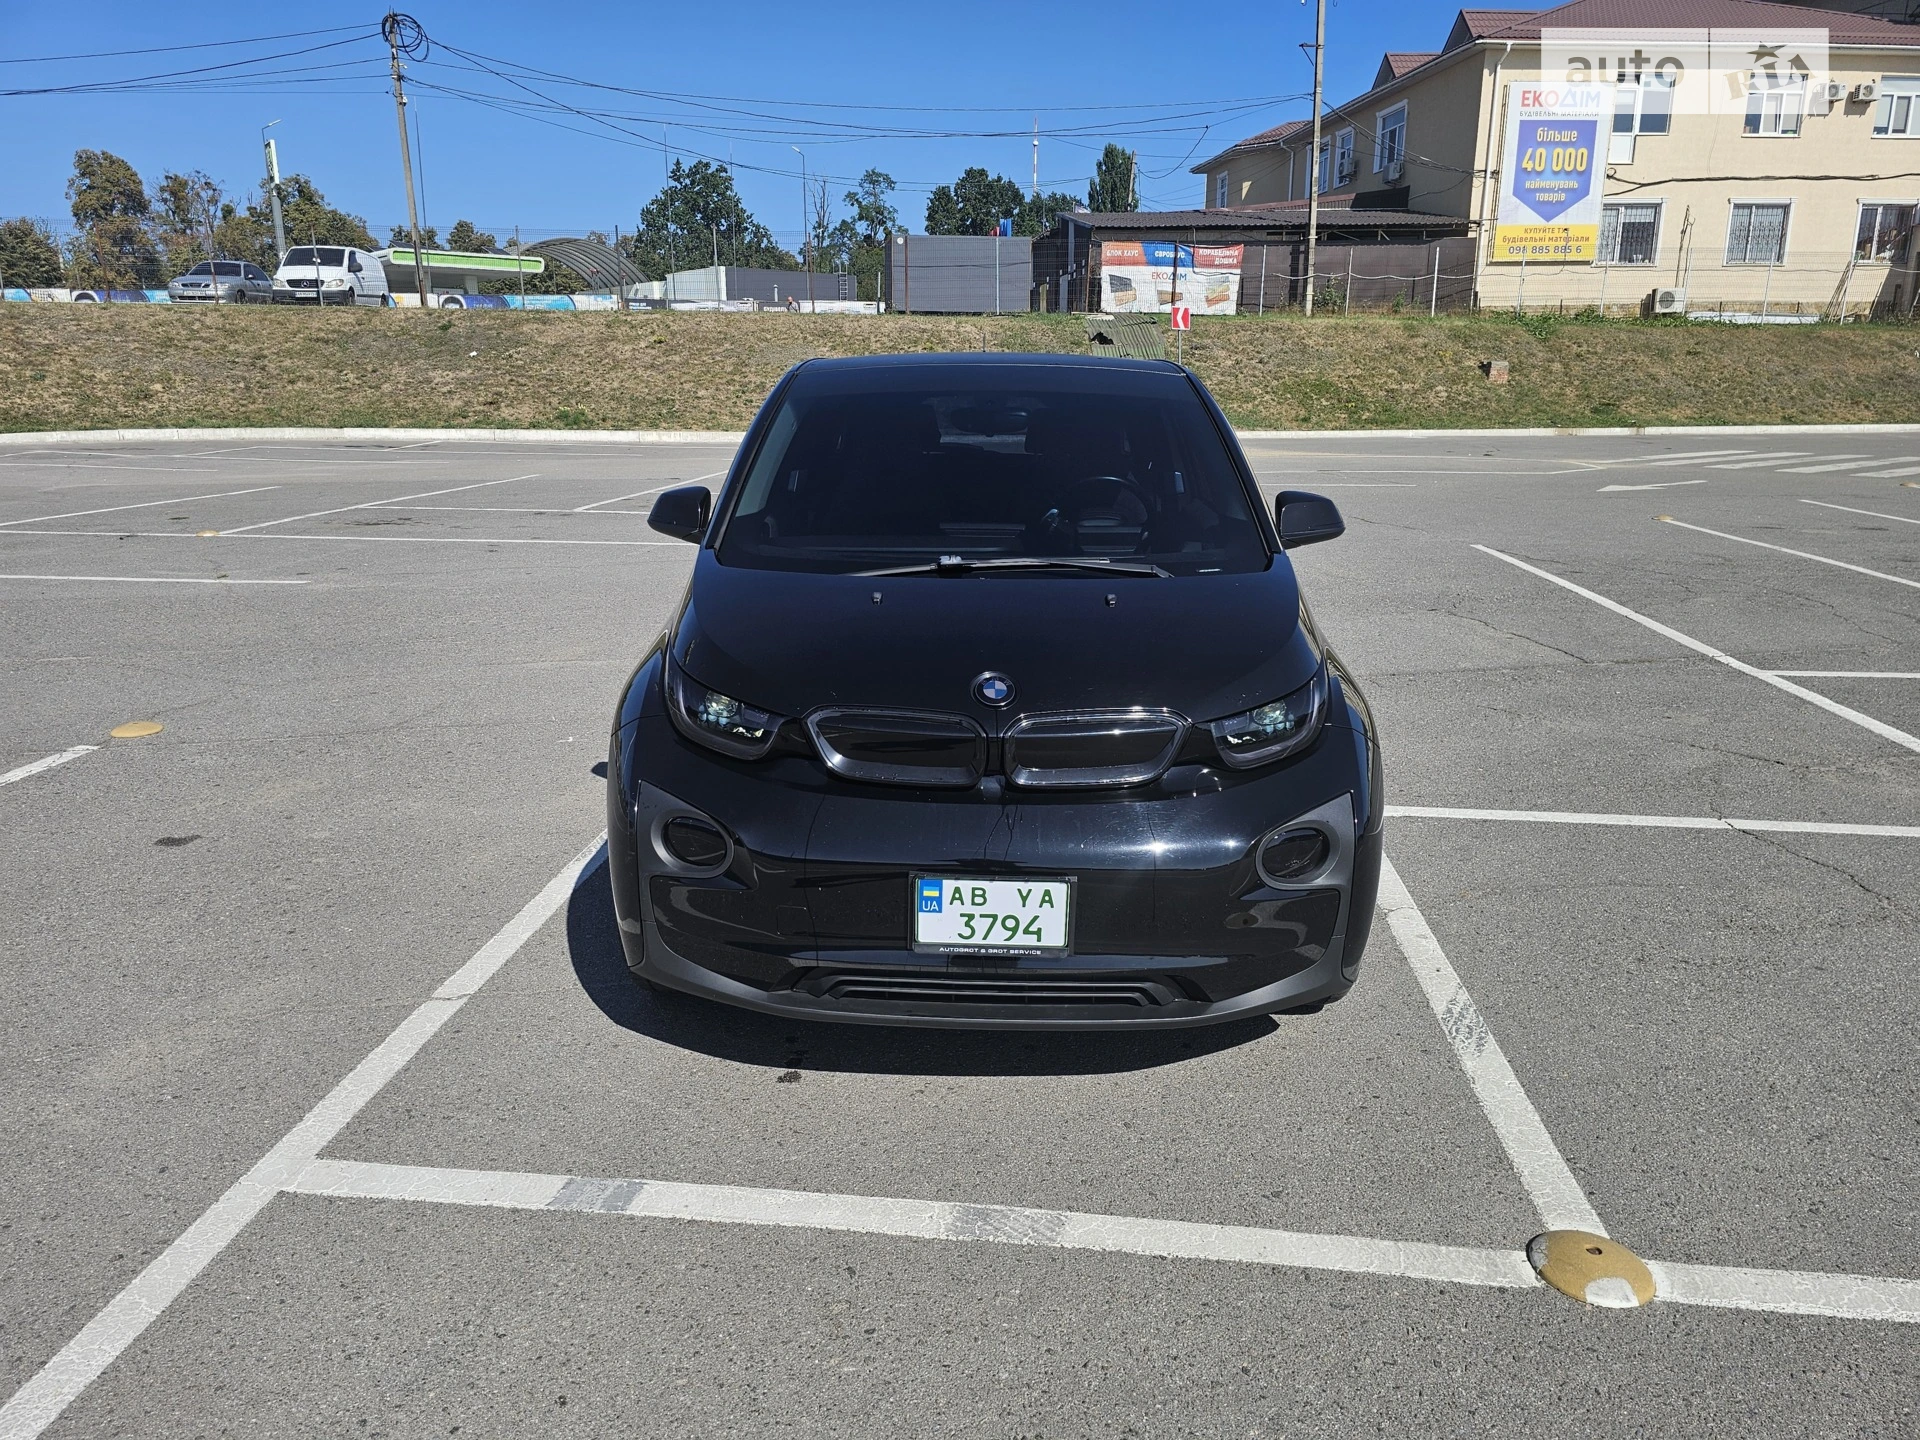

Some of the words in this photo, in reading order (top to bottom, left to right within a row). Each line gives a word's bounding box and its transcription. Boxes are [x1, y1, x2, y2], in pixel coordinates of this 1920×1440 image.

[1536, 127, 1578, 143] більше
[1521, 147, 1547, 172] 40
[1551, 147, 1589, 172] 000
[1525, 178, 1579, 191] найменувань
[1535, 191, 1566, 203] товарів
[1523, 226, 1556, 234] КУПУЙТЕ
[1502, 235, 1546, 245] будівельні
[1547, 234, 1590, 243] матеріали
[1106, 249, 1122, 257] БЛОК
[1123, 249, 1139, 257] ХАУС
[1154, 250, 1186, 259] ЄВРОБУС
[1198, 248, 1239, 256] КОРАБЕЛЬНА
[1508, 245, 1528, 255] 098
[1531, 245, 1551, 254] 885
[1553, 245, 1573, 254] 885
[1575, 245, 1582, 254] 6
[1214, 257, 1237, 265] ДОШКА
[949, 886, 988, 907] AB
[1017, 888, 1055, 908] YA
[922, 900, 939, 911] UA
[957, 913, 1042, 942] 3794
